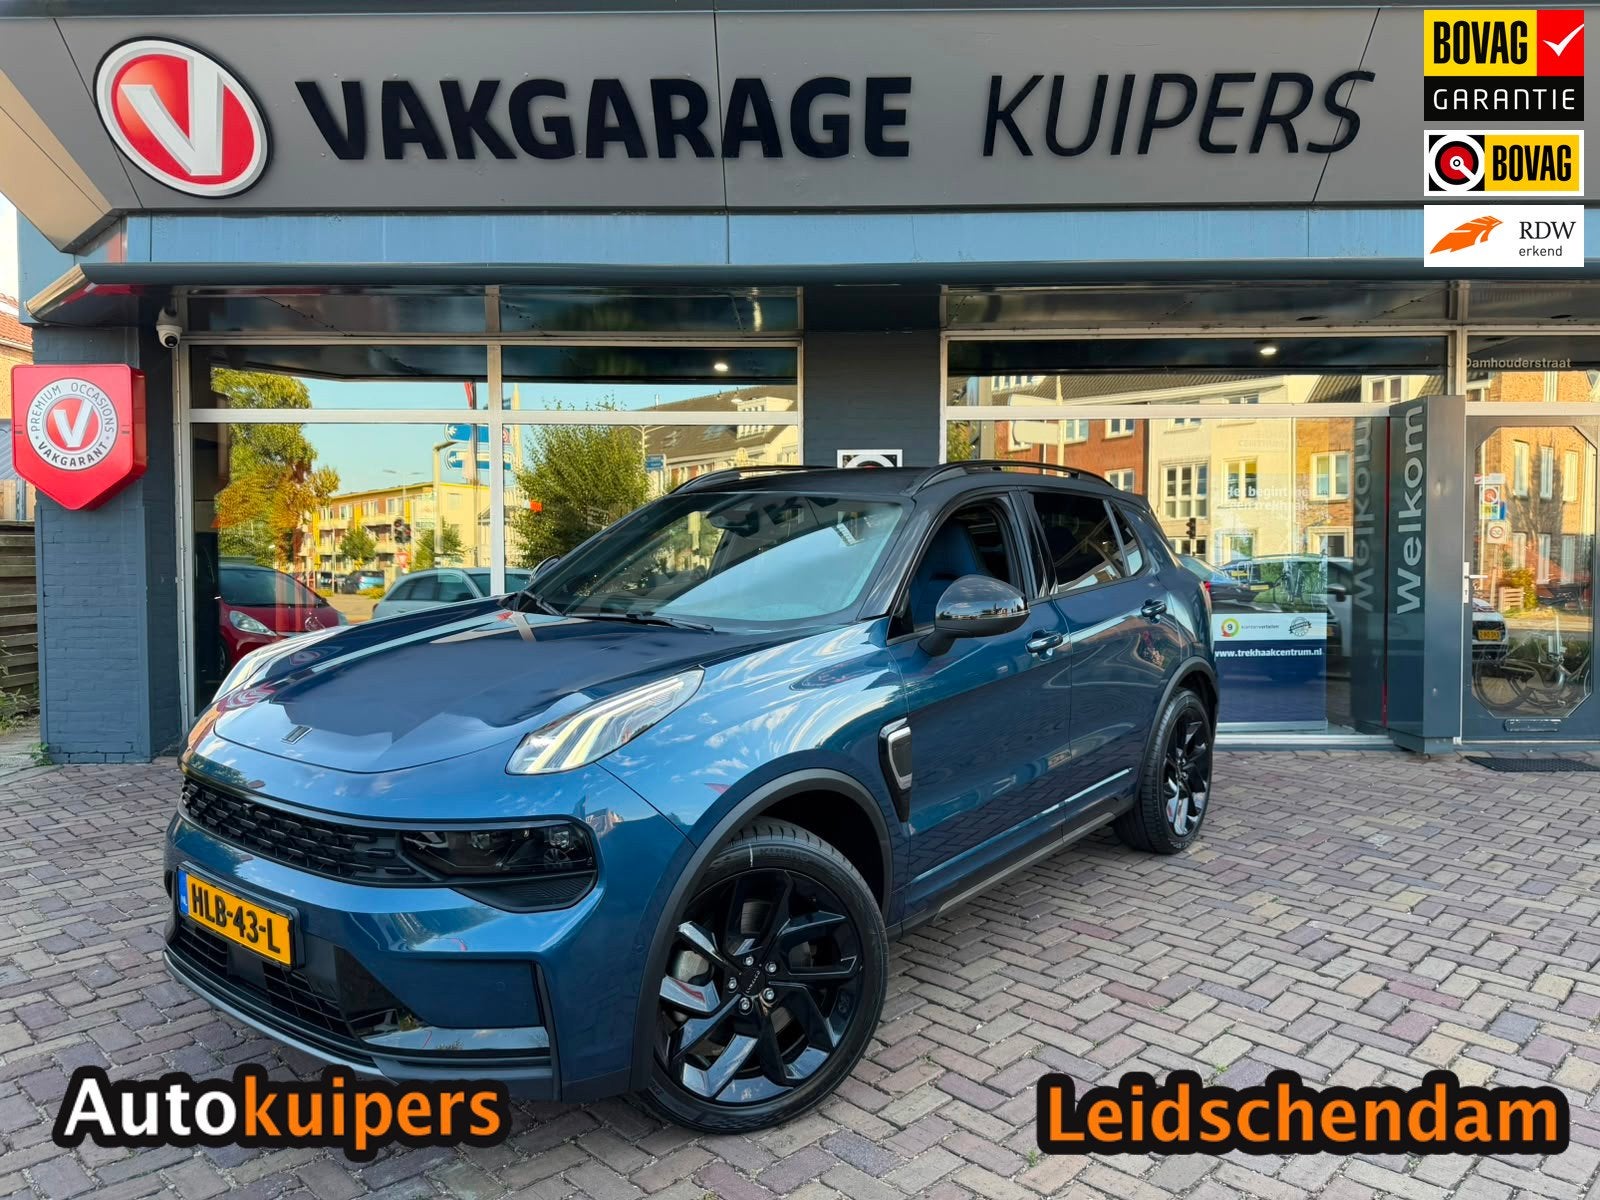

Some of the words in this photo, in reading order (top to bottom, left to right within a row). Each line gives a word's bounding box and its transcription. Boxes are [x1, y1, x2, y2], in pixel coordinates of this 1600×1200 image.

[295, 77, 911, 161] VAKGARAGE
[983, 71, 1375, 157] KUIPERS
[1466, 358, 1571, 368] Damhouderstraat
[30, 385, 61, 432] PREMIUM
[71, 382, 115, 433] OCCASIONS
[38, 441, 108, 467] VAKGARANT
[1397, 406, 1423, 614] Welkom
[191, 883, 281, 954] HLB-43-L
